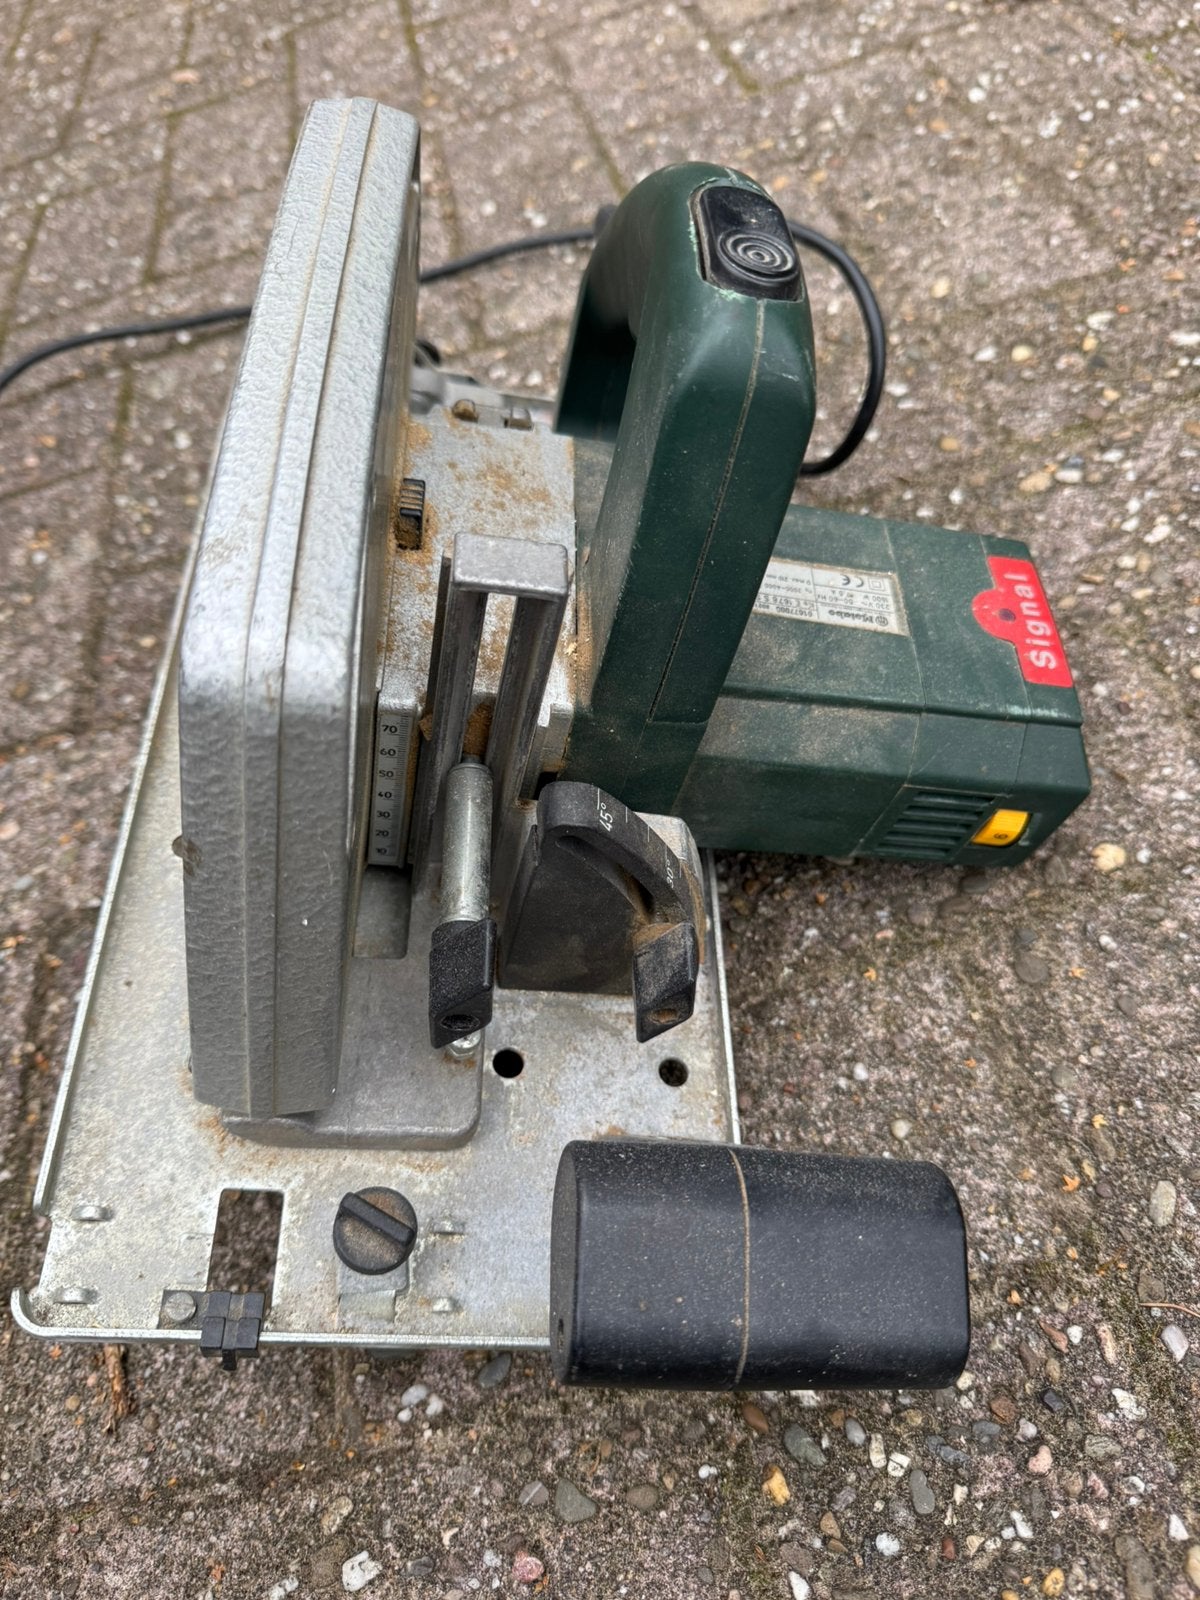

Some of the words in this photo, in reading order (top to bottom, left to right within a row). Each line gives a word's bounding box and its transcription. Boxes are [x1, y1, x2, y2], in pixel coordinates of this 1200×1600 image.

[841, 574, 864, 588] CE
[828, 609, 874, 624] Metabo
[1004, 573, 1057, 669] Signal
[382, 725, 398, 734] 70
[380, 748, 397, 757] 60
[378, 770, 394, 778] 50
[377, 791, 392, 799] 40
[599, 803, 613, 832] 45°
